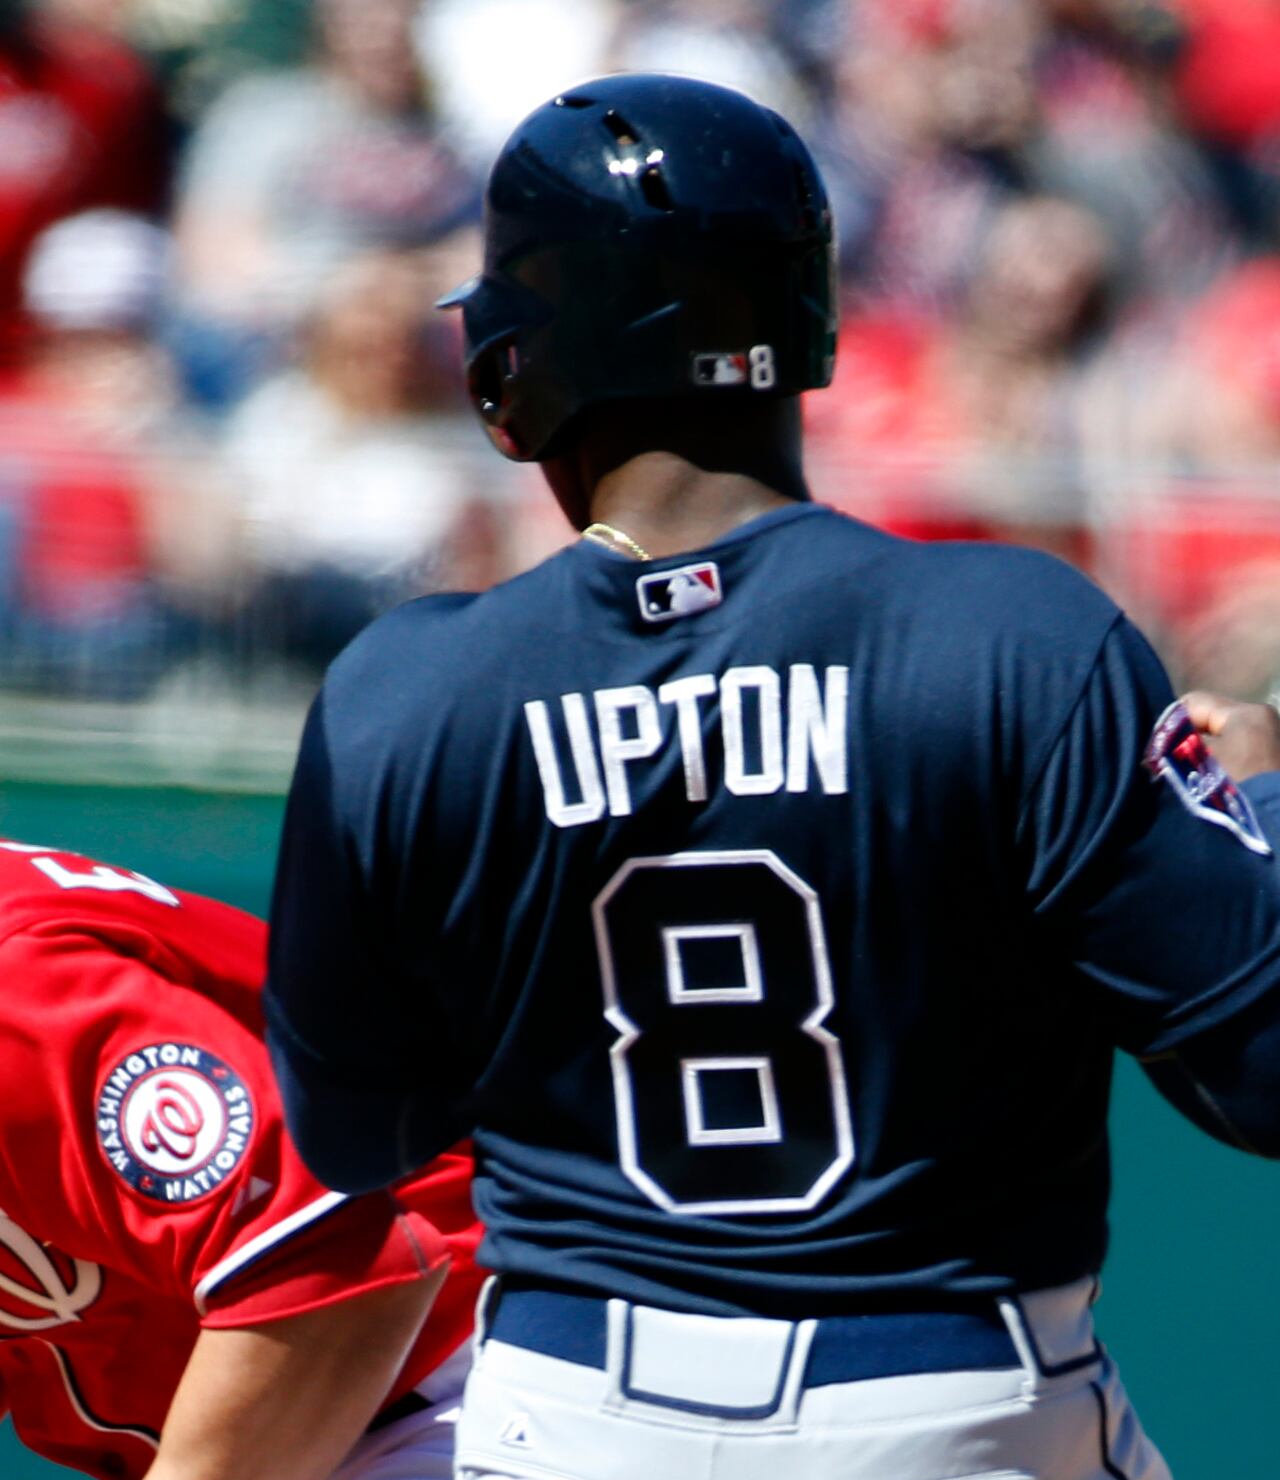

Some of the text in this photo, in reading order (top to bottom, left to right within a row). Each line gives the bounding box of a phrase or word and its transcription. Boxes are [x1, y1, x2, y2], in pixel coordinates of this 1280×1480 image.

[748, 344, 775, 389] 8
[524, 663, 850, 828] UPTON
[591, 849, 856, 1214] 8
[97, 1043, 200, 1172] WASHINGTON
[140, 1079, 205, 1160] W
[165, 1085, 252, 1200] NATIONALS
